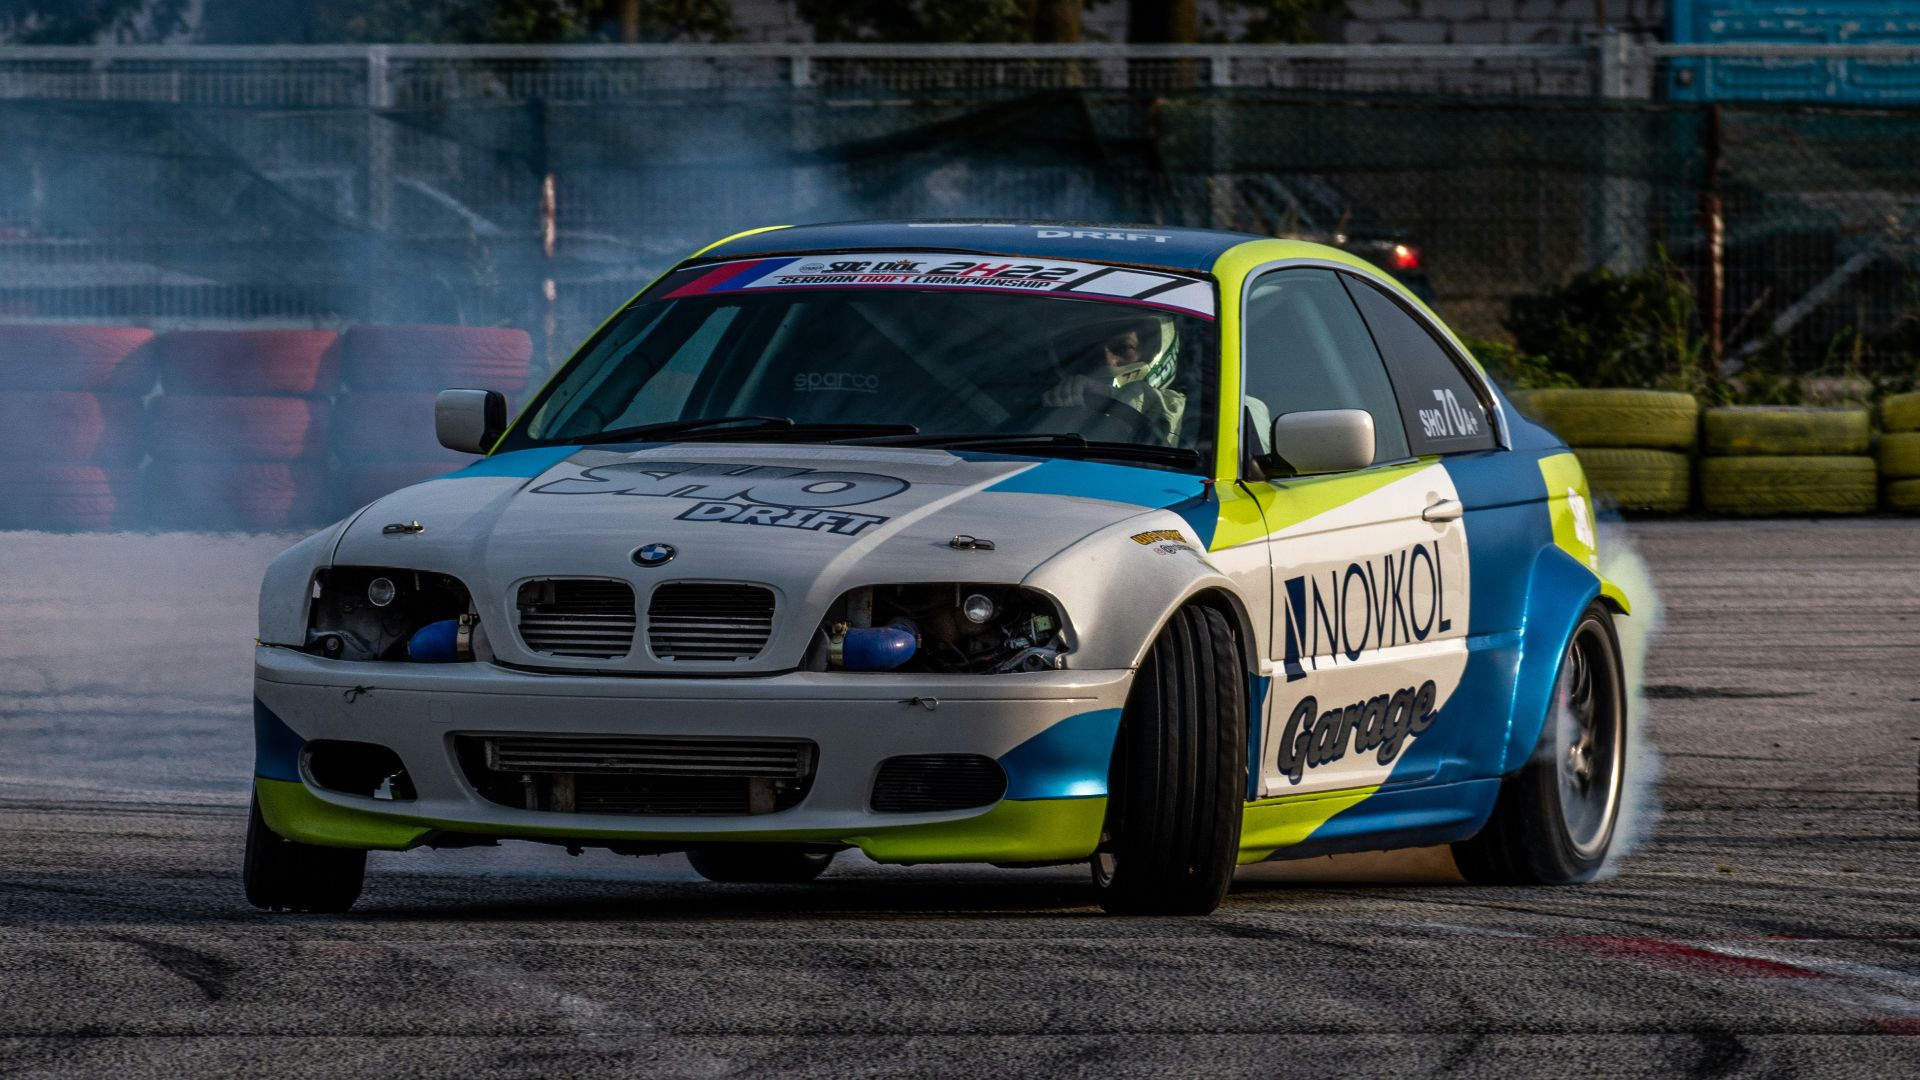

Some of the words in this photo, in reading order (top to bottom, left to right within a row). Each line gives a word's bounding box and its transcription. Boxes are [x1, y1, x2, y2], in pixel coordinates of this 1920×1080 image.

[1036, 229, 1173, 244] DRIFT
[777, 275, 860, 285] SERBIAN
[857, 274, 912, 284] DRIFT
[911, 274, 1052, 289] CHAMPIONSHIP
[793, 372, 880, 393] sparco
[674, 501, 891, 537] DRIFT
[1277, 679, 1439, 786] Garage
